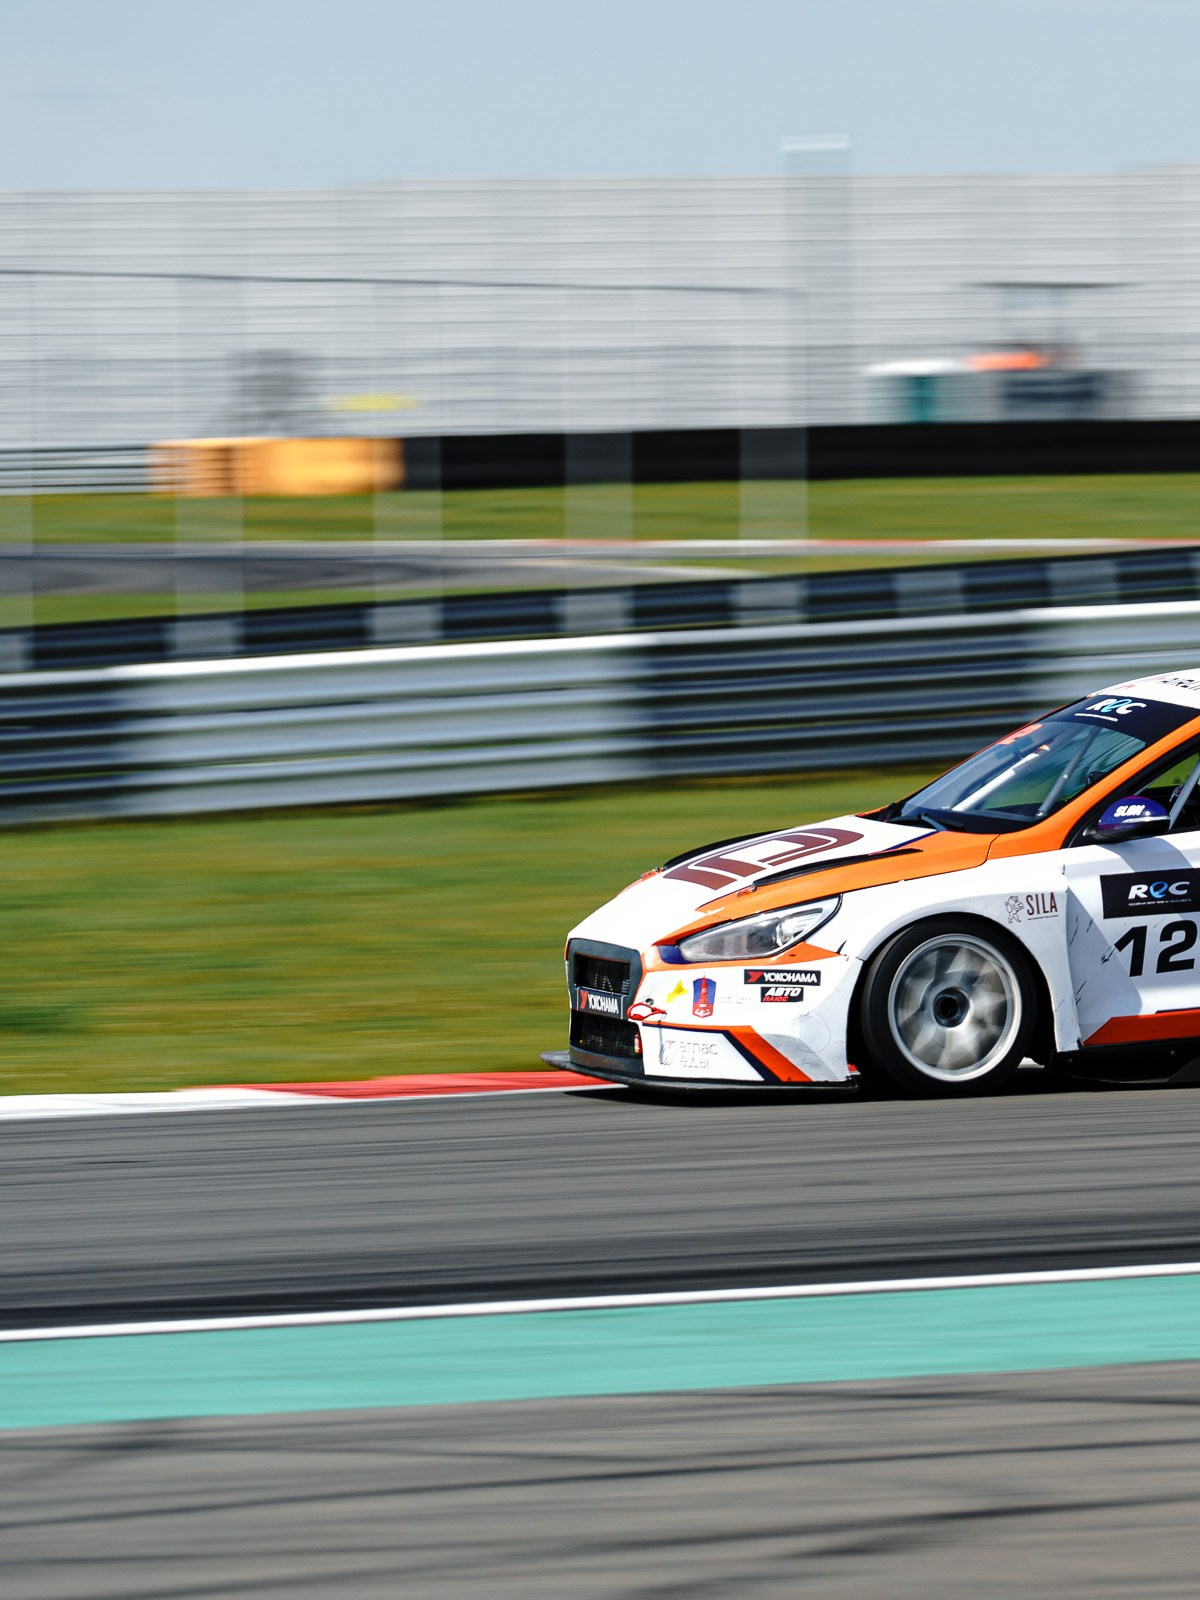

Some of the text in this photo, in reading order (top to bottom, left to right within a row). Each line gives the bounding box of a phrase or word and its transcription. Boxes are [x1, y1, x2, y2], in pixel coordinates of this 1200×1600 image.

[1025, 892, 1058, 916] SILA
[1114, 919, 1198, 977] 12
[763, 972, 818, 983] YOKOHAMA
[587, 993, 619, 1015] YOKOHAMA
